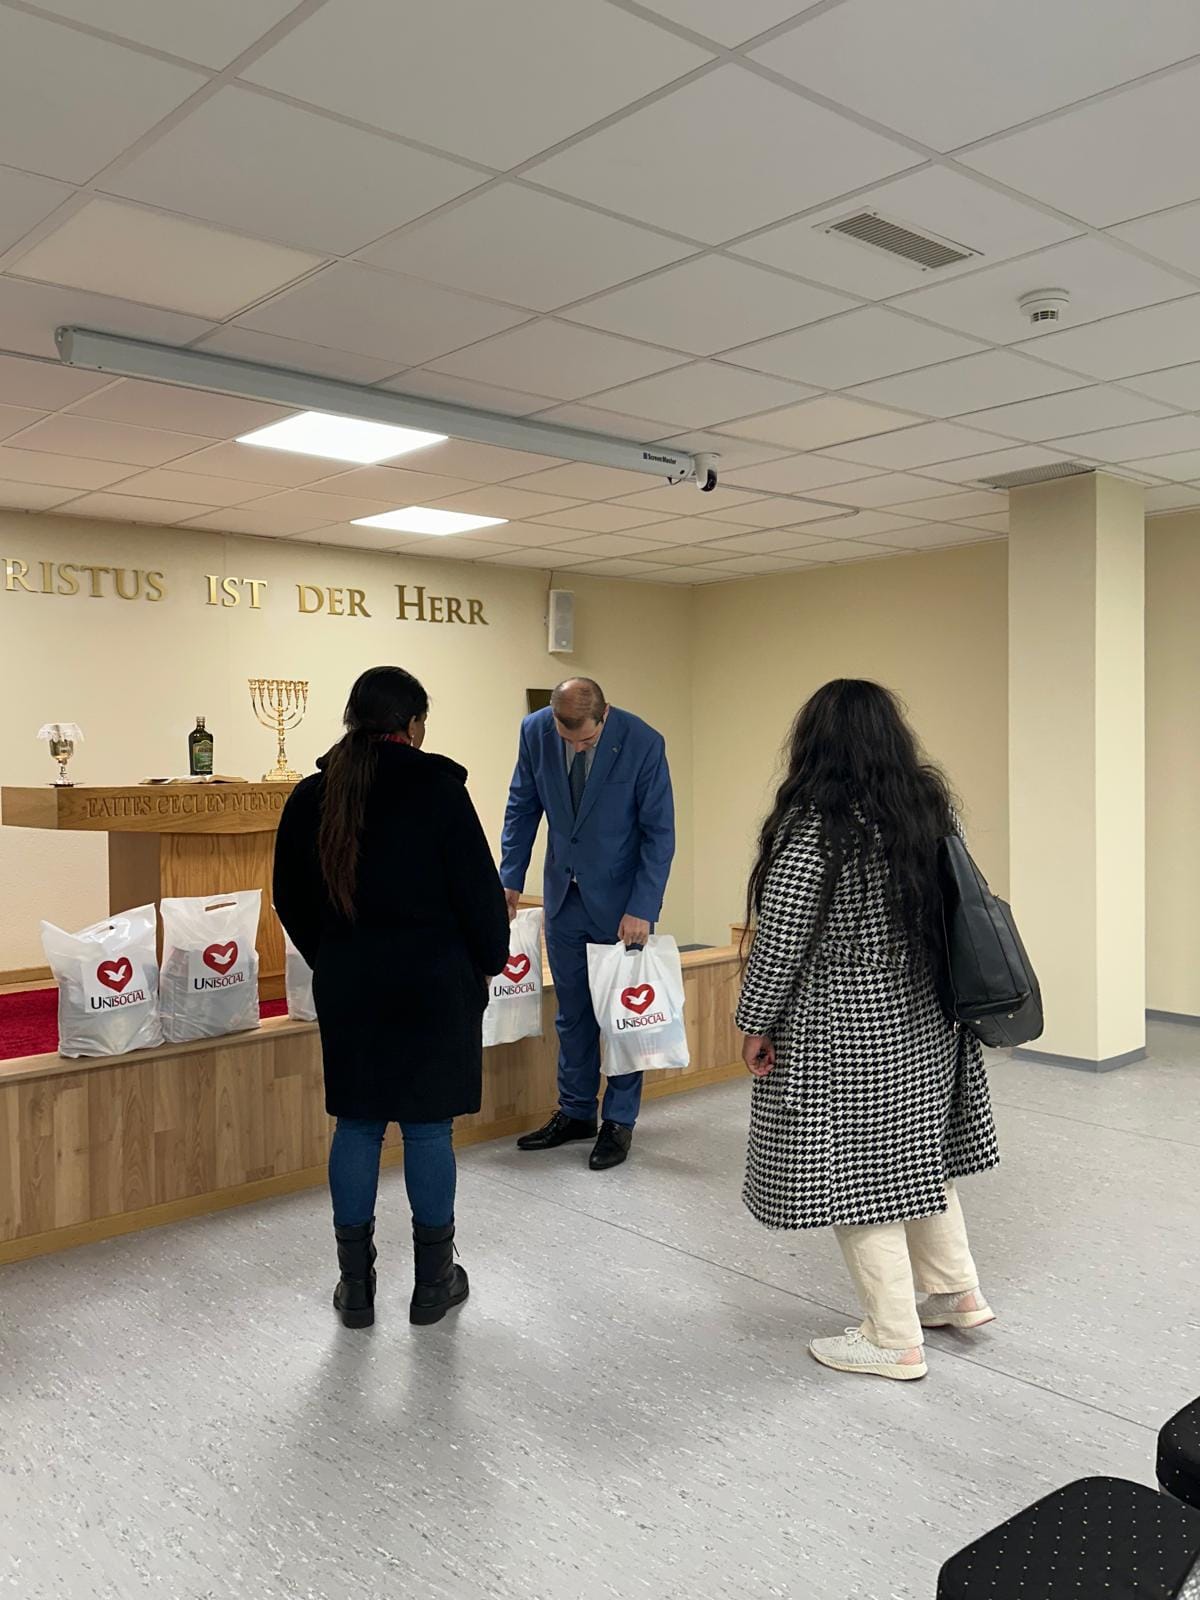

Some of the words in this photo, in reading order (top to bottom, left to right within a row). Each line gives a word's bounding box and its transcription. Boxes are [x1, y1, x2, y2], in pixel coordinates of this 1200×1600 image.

[2, 558, 166, 601] RISTUS
[204, 574, 268, 609] IST
[296, 584, 372, 618] DER
[394, 584, 490, 625] HERR
[195, 971, 245, 990] UNISOCIAL
[493, 981, 536, 997] UNISOCIAL
[90, 989, 146, 1010] UNISOCIAL
[616, 1012, 666, 1030] UNISOCIAL
